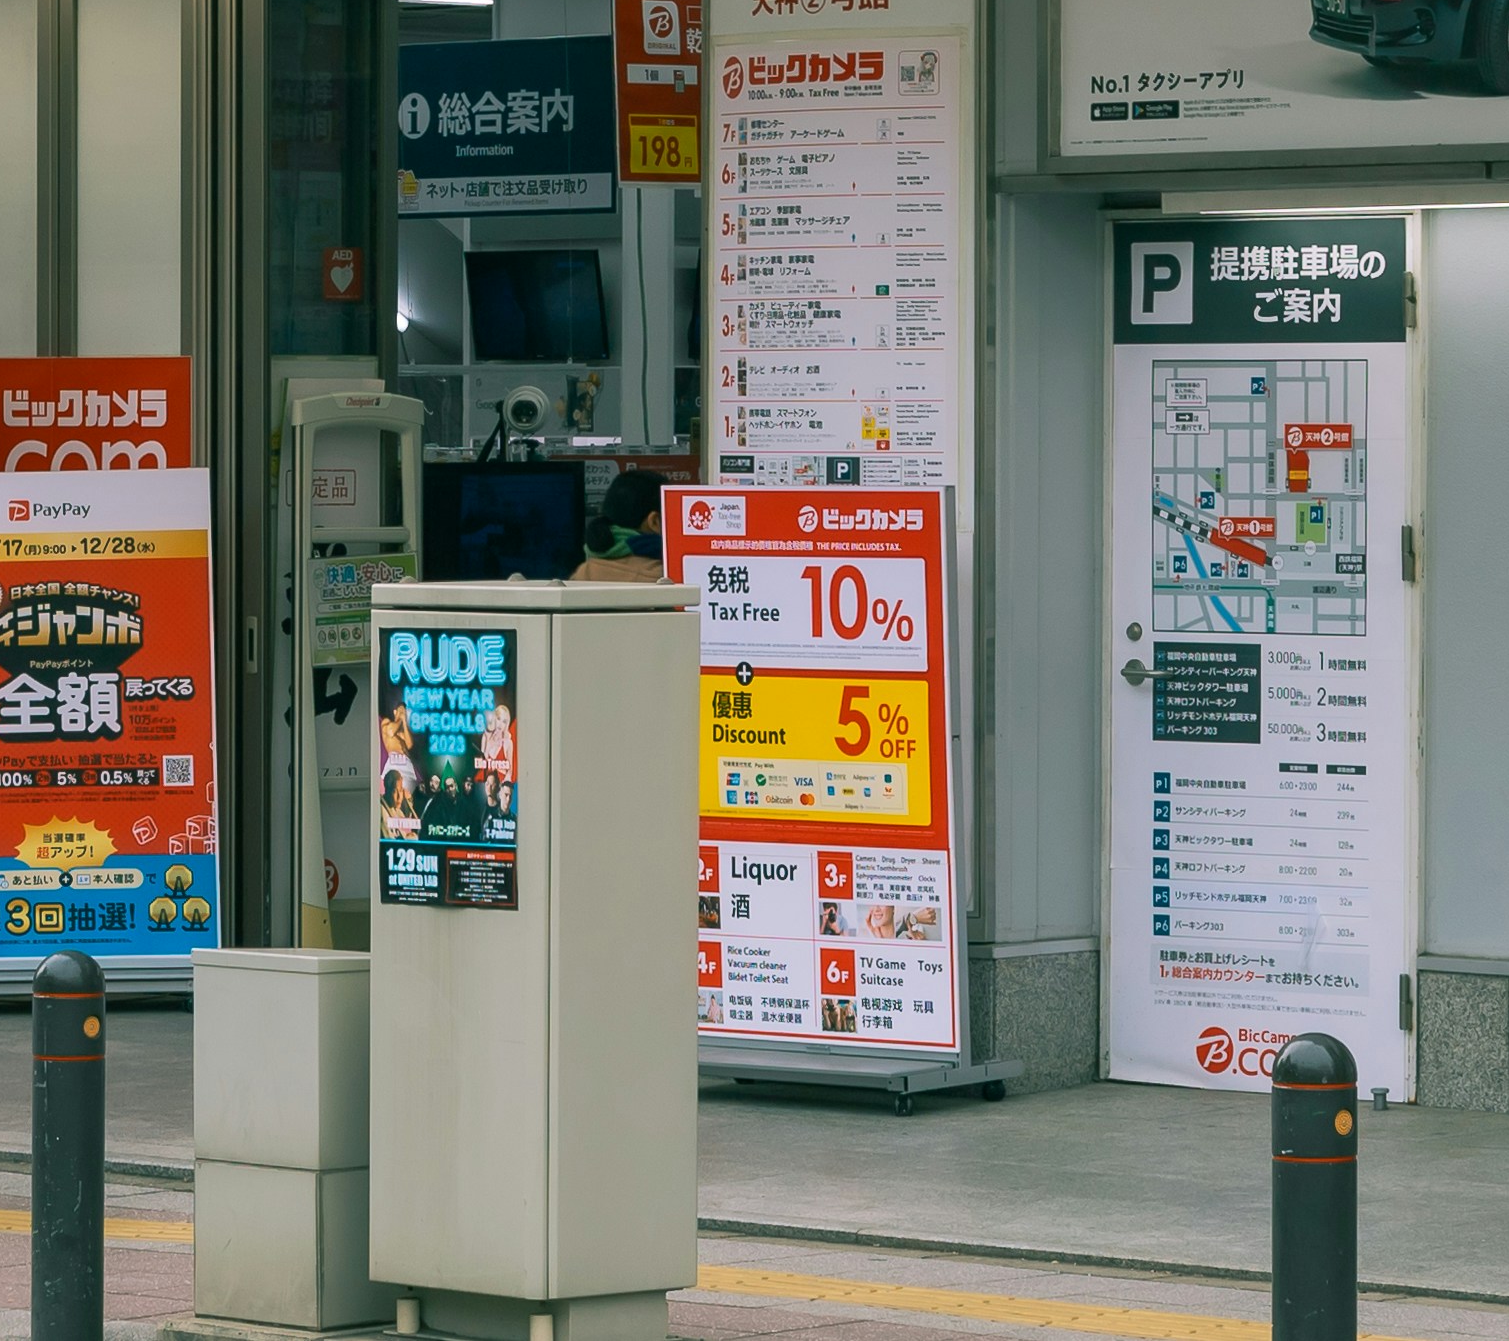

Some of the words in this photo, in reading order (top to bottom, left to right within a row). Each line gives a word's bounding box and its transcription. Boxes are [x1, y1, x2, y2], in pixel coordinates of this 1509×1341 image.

[749, 51, 884, 86] ビックカメラ
[1091, 75, 1130, 95] No.1
[1137, 68, 1244, 92] タクシーアプリ
[438, 88, 575, 138] 総合案内
[456, 144, 513, 157] Information
[332, 250, 353, 261] AED
[1210, 245, 1386, 281] 提携駐車場の
[1142, 252, 1182, 313] P
[1253, 287, 1342, 324] ご案内
[2, 389, 167, 427] ビックカメラ
[33, 502, 91, 519] PayPay
[822, 508, 924, 531] ビックカメラ
[707, 565, 750, 594] 免税
[708, 601, 738, 621] Tax
[744, 603, 780, 622] Free
[801, 564, 914, 642] 10%
[390, 632, 507, 686] RUDE
[1328, 658, 1367, 672] 時間無料
[125, 678, 194, 698] 戻ってくる
[403, 686, 443, 710] NEW
[446, 687, 495, 711] YEAR
[1328, 693, 1367, 707] 時間無料
[429, 734, 465, 756] 2023
[712, 723, 786, 747] Discount
[1328, 728, 1367, 743] 時間無料
[879, 739, 917, 759] OFF
[794, 776, 814, 787] VISA
[386, 848, 416, 872] 1.29
[731, 855, 797, 885] Liquor
[855, 855, 877, 863] Camera
[727, 946, 743, 956] Rice
[744, 947, 771, 957] Cooker
[860, 957, 874, 970] TV
[875, 957, 906, 971] Game
[918, 959, 943, 974] Toys
[860, 974, 904, 988] Suitcase
